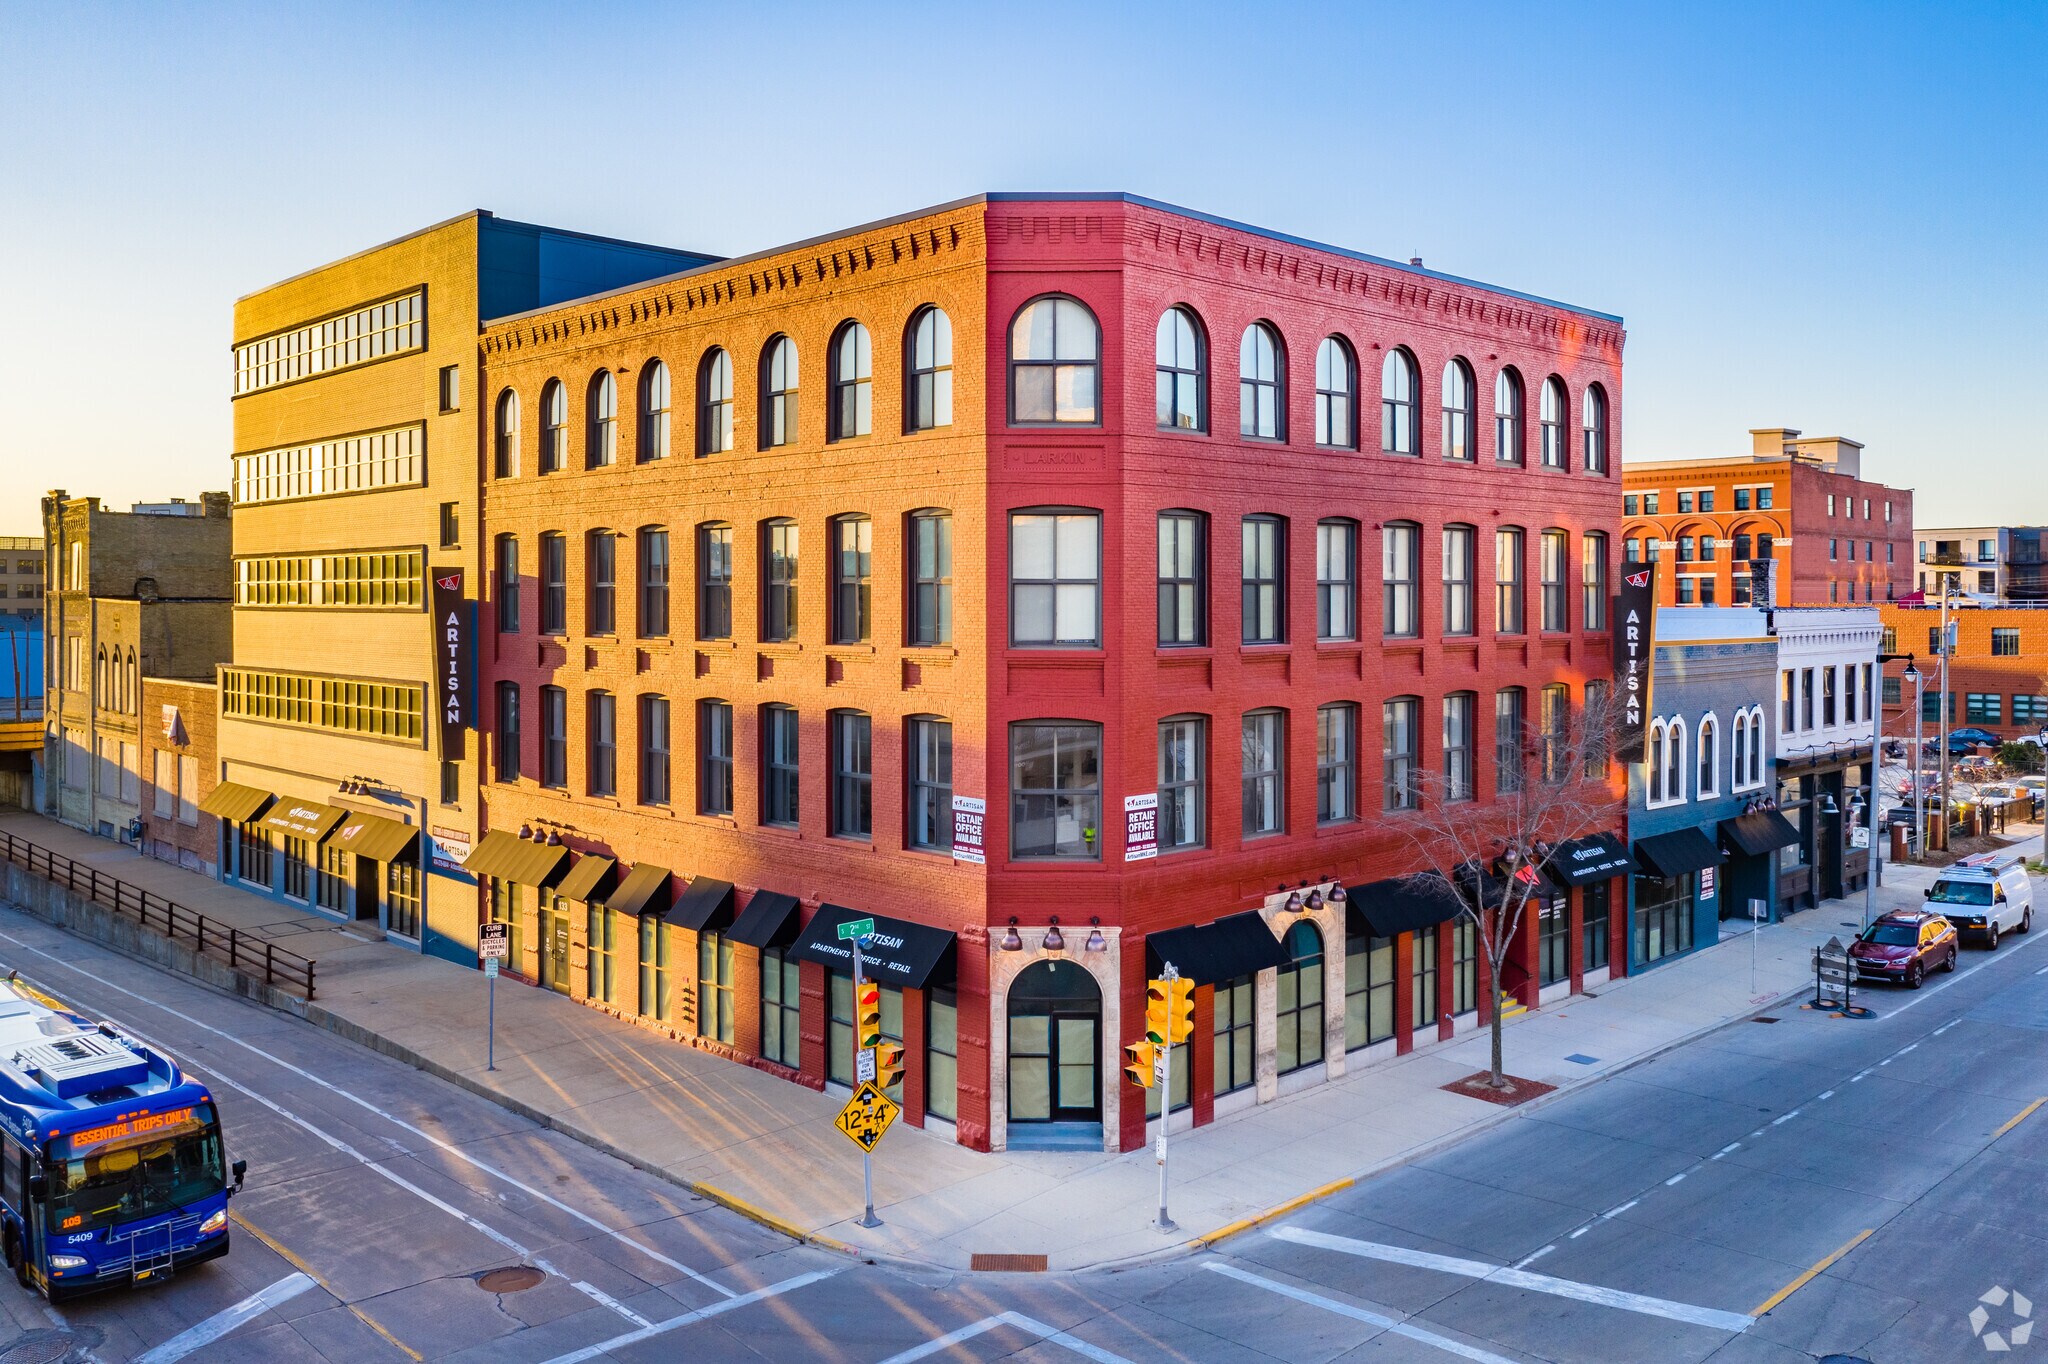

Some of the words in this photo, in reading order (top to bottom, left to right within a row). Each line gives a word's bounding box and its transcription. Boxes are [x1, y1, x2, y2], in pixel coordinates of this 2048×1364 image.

[1024, 452, 1085, 465] LARKIN
[446, 611, 460, 724] ARTISAN
[1626, 609, 1640, 725] ARTISAN
[962, 802, 984, 810] ARTISAN
[1135, 798, 1156, 806] ARTISAN
[1129, 811, 1154, 823] RETAIL
[955, 822, 982, 836] OFFICE
[1128, 820, 1155, 833] OFFICE
[955, 832, 982, 846] AVAILABLE
[1128, 830, 1155, 843] AVAILABLE
[445, 845, 468, 857] ARTISAN
[558, 901, 568, 911] 133
[486, 931, 502, 939] LANE
[810, 942, 851, 958] APARTMENTS
[888, 962, 912, 974] RETAIL
[858, 1057, 874, 1065] BUTTON
[859, 1072, 874, 1080] SIGNAL
[74, 1124, 130, 1147] ESSENTIAL
[134, 1114, 164, 1132] TRIPS
[165, 1108, 192, 1125] ONLY
[68, 1232, 93, 1245] 5409
